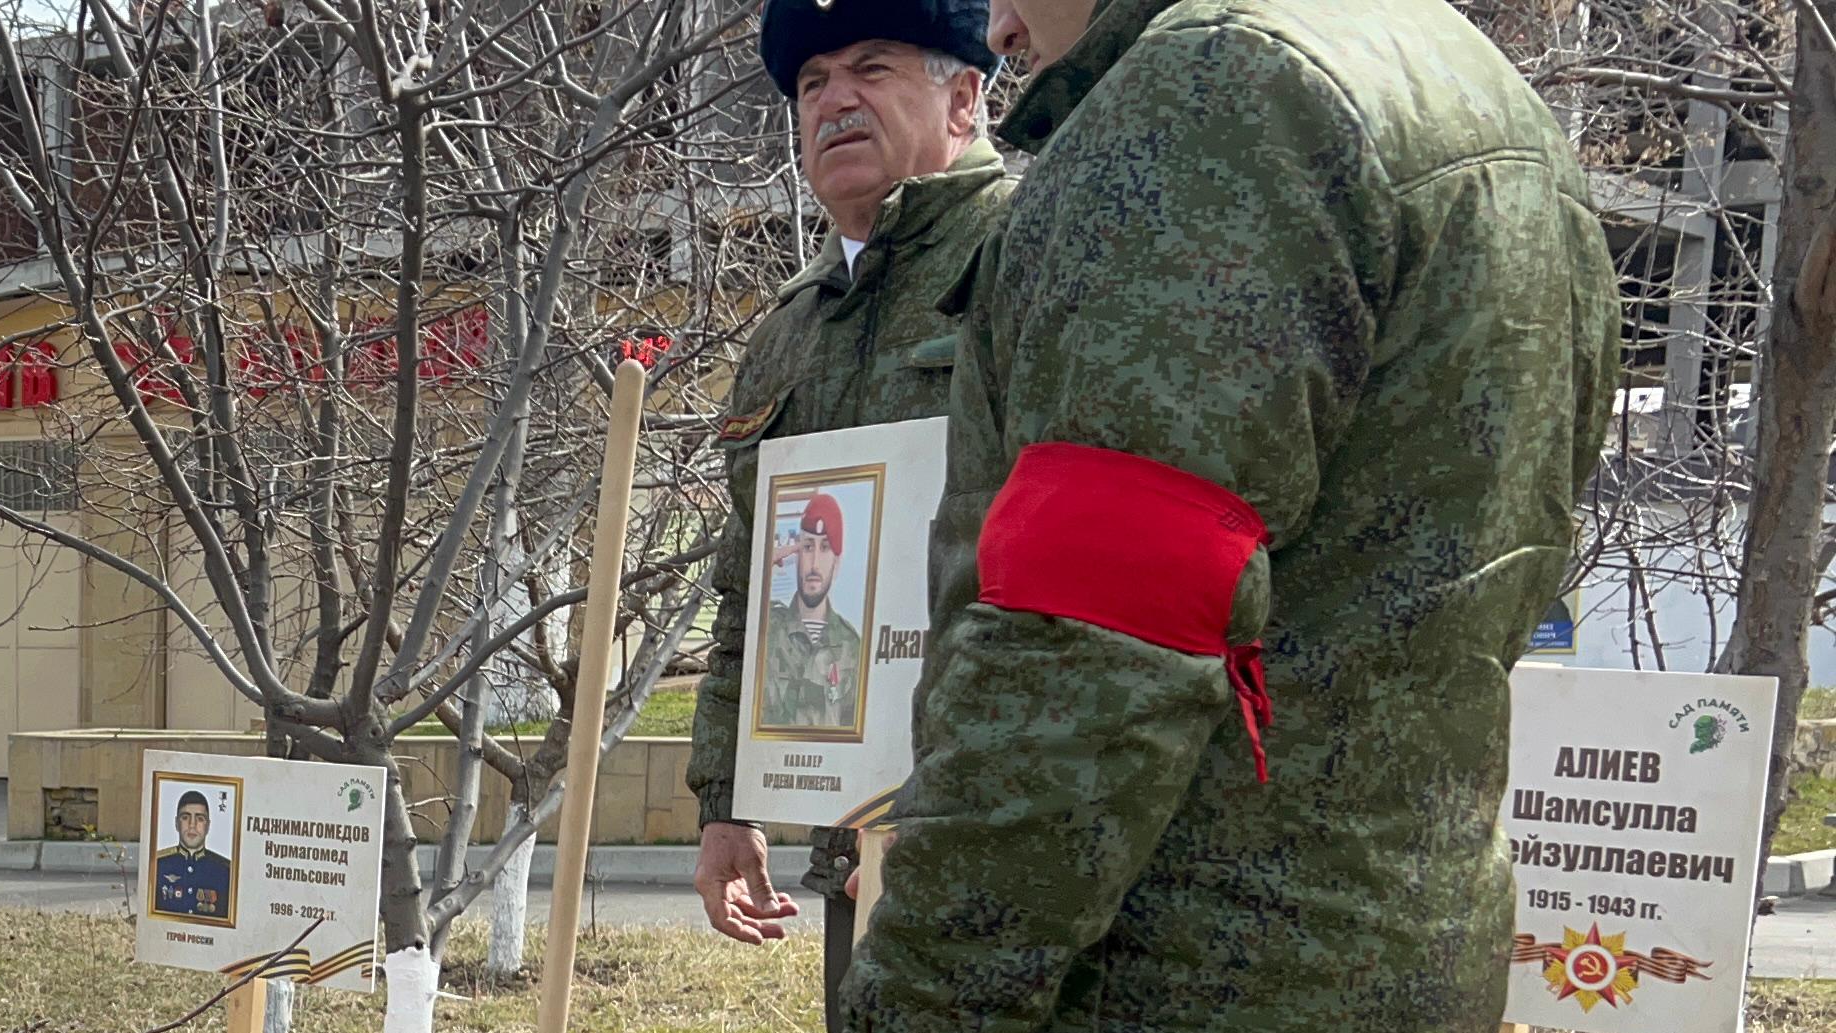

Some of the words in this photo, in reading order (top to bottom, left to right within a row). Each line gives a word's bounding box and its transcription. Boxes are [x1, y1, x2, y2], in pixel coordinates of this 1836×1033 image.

[875, 624, 924, 664] Джа
[1669, 704, 1695, 729] САД
[1697, 698, 1750, 733] ПАМЯТИ
[784, 754, 823, 768] КАВАЛЕР
[1554, 746, 1661, 783] АЛИЕВ
[337, 781, 350, 796] САД
[350, 778, 375, 799] ПАМЯТИ
[763, 773, 794, 791] ОРДЕНА
[795, 774, 842, 792] МУЖЕСТВА
[1512, 789, 1698, 833] Шамсулла
[246, 816, 370, 843] ГАДЖИМАГОМЕДОВ
[264, 840, 349, 866] Нурмагомед
[1509, 833, 1735, 883] ейзуллаевич
[265, 863, 346, 886] Энгельсович
[270, 903, 293, 916] 1996
[300, 905, 324, 919] 2022
[1527, 889, 1571, 911] 1915
[1587, 894, 1636, 918] 1943
[1641, 902, 1663, 920] гг.
[166, 931, 186, 943] ГЕРОЙ
[187, 934, 214, 946] РОССИИ
